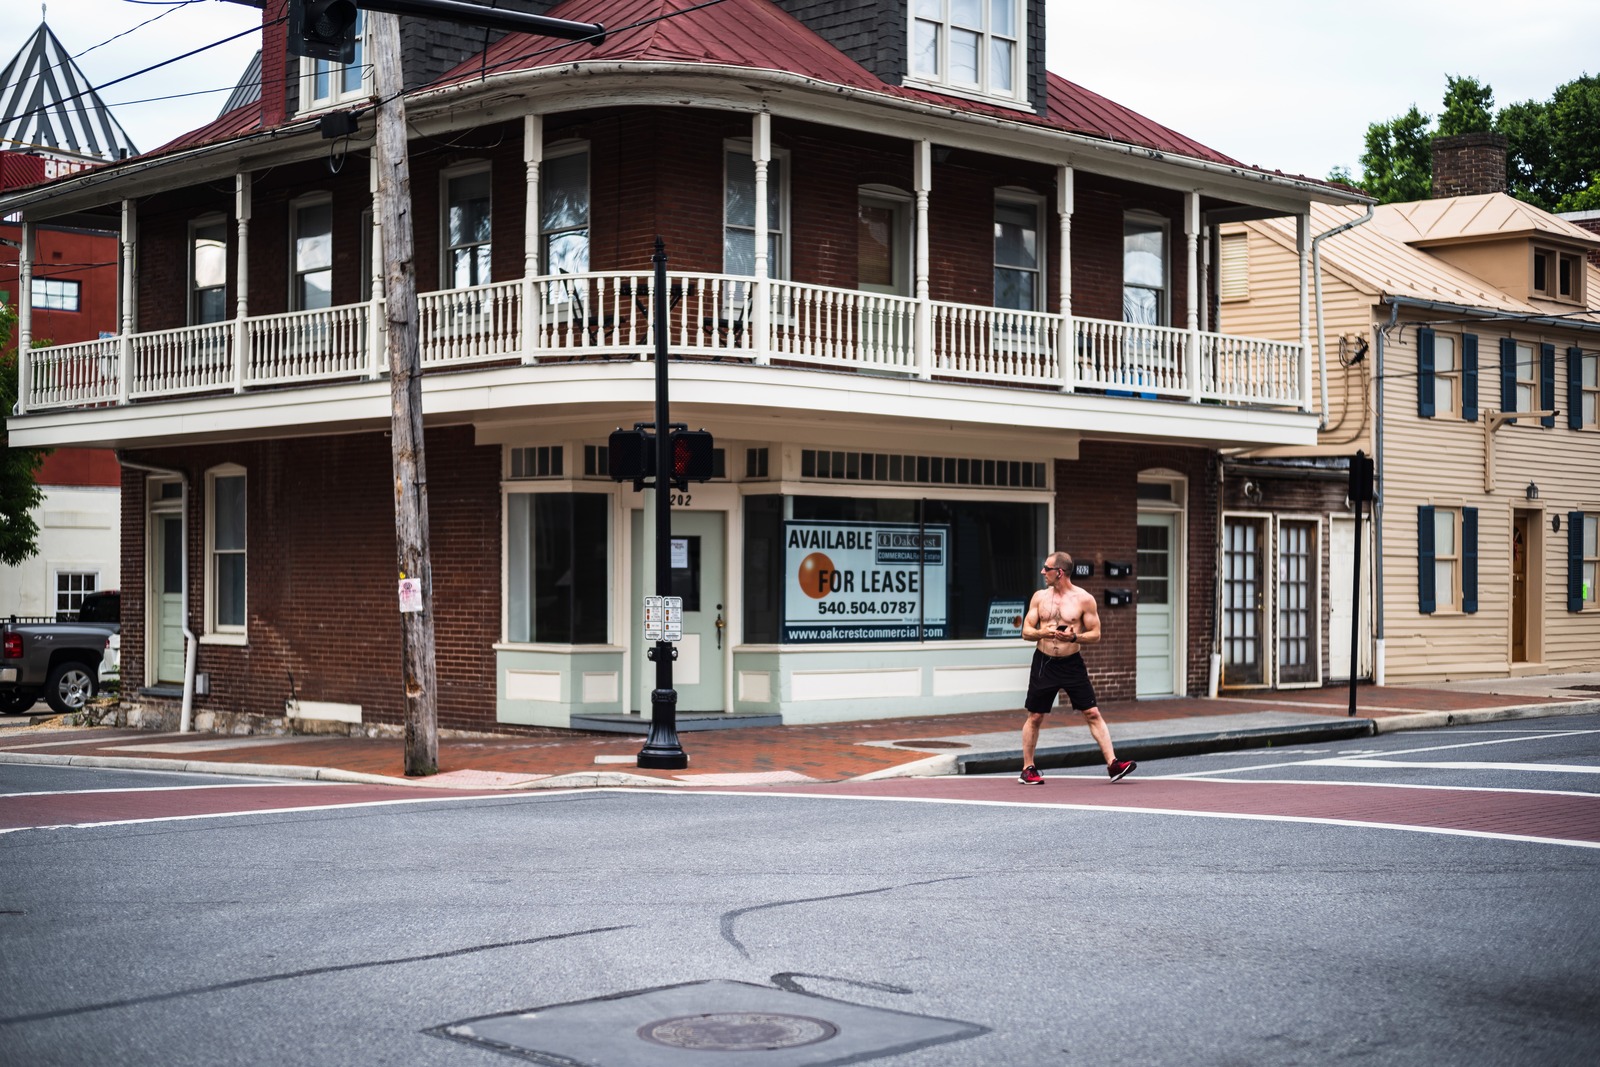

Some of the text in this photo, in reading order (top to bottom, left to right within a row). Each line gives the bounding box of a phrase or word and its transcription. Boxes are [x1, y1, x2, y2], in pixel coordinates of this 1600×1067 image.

[669, 494, 692, 506] 202
[788, 529, 873, 550] AVAILABLE
[893, 534, 936, 547] OakCest
[818, 570, 919, 593] FOR LEASE
[818, 601, 916, 615] 540.504.0787
[989, 616, 1006, 624] LEASE
[788, 625, 944, 641] www.oakcrestcommercialcom
